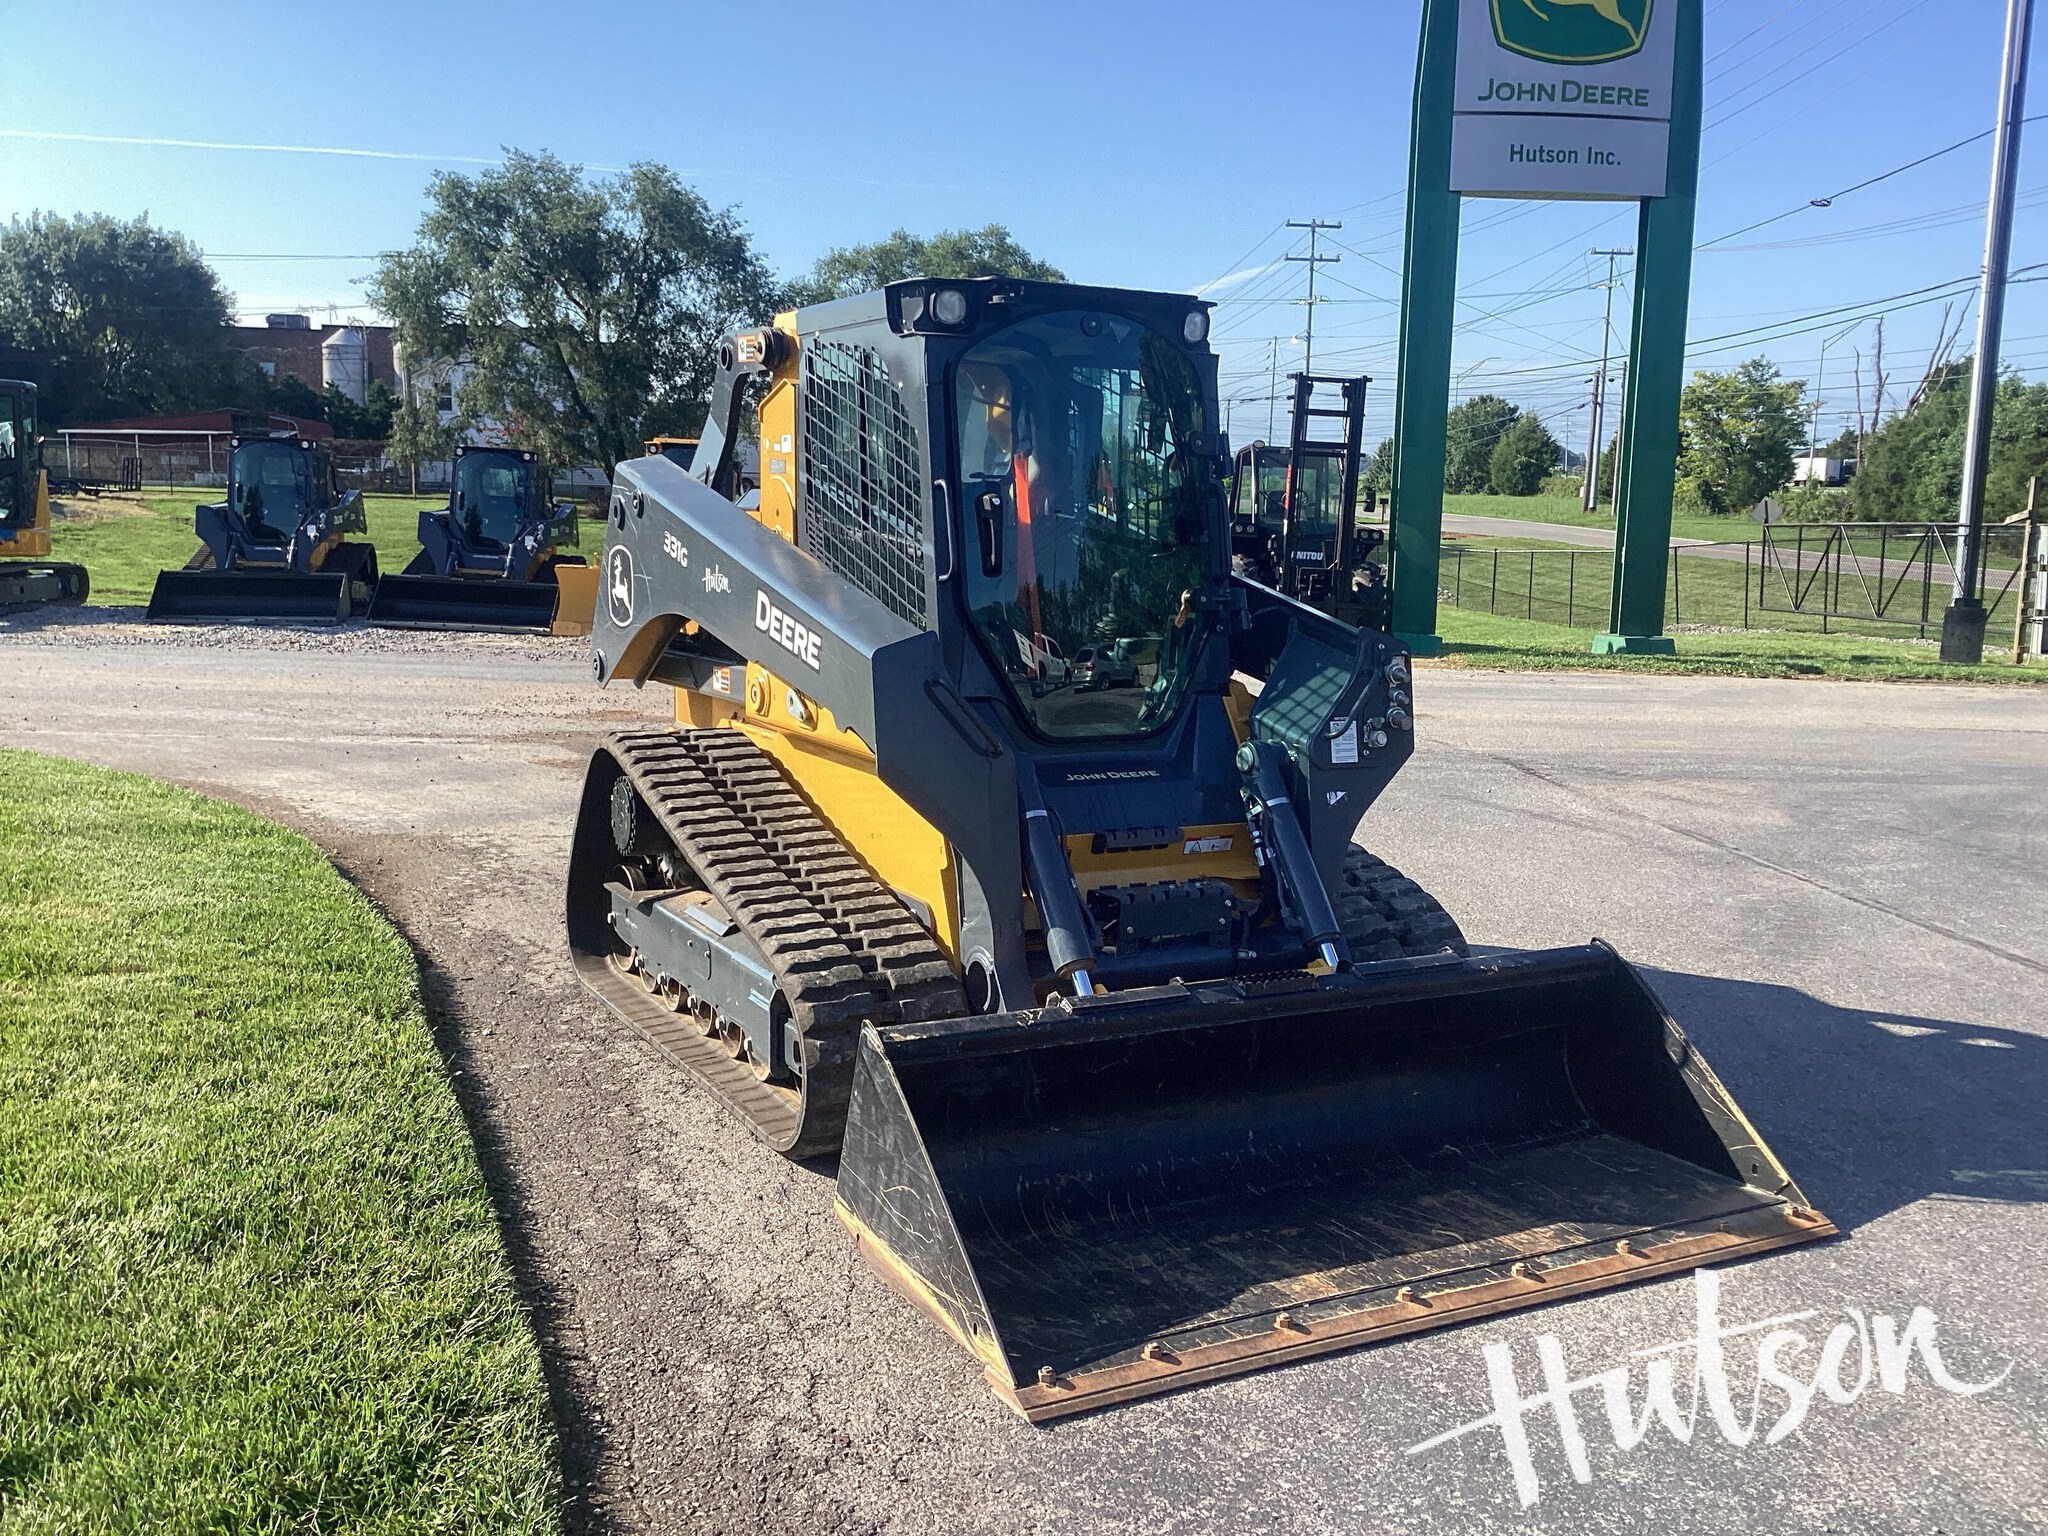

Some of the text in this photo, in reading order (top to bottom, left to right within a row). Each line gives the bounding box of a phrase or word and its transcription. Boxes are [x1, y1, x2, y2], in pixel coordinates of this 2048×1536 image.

[1477, 78, 1650, 107] JOHN DEERE
[1509, 143, 1622, 166] Hutson Inc.
[663, 530, 688, 568] 331G
[1291, 551, 1324, 560] NITOU
[755, 589, 822, 671] DEERE
[1066, 770, 1160, 781] JOHN DEERE
